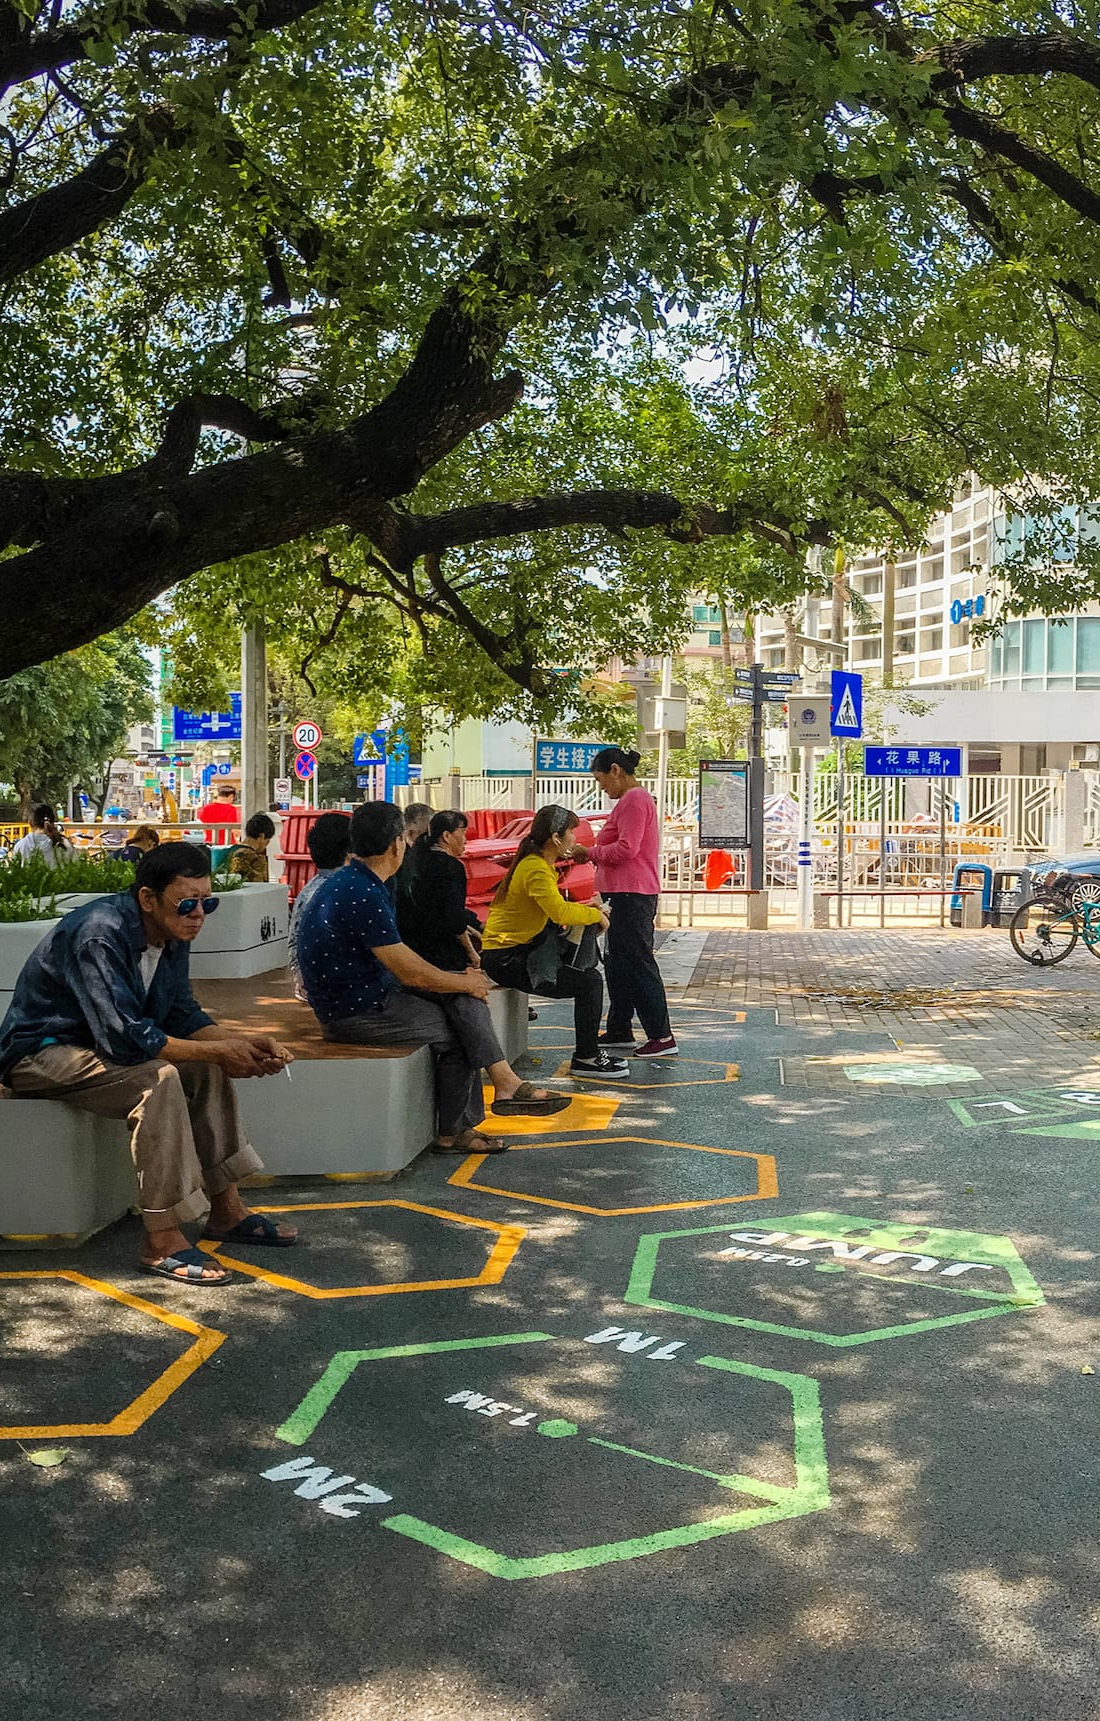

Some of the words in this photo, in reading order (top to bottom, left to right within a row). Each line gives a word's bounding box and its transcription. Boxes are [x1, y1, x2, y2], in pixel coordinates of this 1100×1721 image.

[300, 729, 314, 742] 20
[886, 750, 942, 765] 花果路
[972, 1100, 1030, 1115] 7
[717, 1246, 811, 1267] 0.25M
[729, 1231, 993, 1277] JUMP
[583, 1326, 688, 1361] 1M
[444, 1389, 538, 1427] 1.5M
[259, 1456, 394, 1519] 2M
